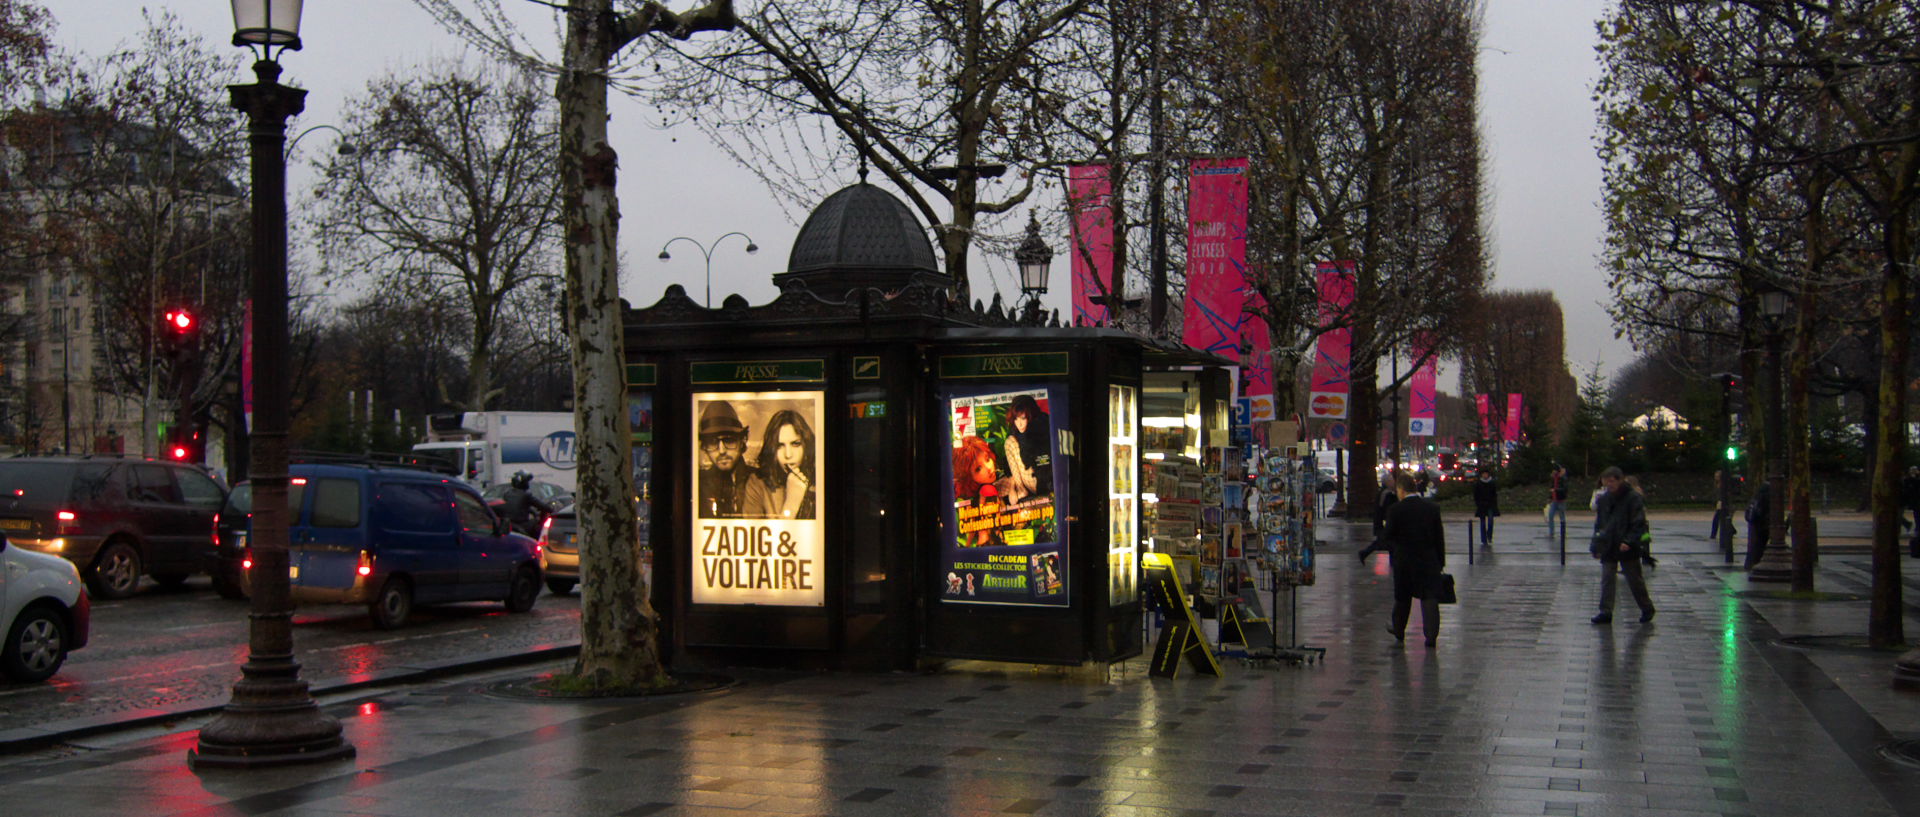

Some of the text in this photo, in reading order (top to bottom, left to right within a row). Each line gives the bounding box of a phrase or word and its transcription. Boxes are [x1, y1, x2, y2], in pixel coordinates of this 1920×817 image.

[1193, 222, 1226, 237] CHAMPS
[1191, 262, 1225, 275] 2010
[735, 364, 780, 380] PRESSE
[982, 357, 1024, 374] PRESSE
[541, 437, 578, 463] NJ
[959, 517, 994, 534] Confessions
[995, 514, 1012, 527] d'une
[1012, 508, 1041, 526] princesse
[1042, 505, 1054, 521] pop
[702, 526, 797, 557] ZADIG &
[964, 562, 992, 570] STICKERS
[989, 555, 1027, 563] EN CADEAU
[702, 558, 813, 590] VOLTAIRE
